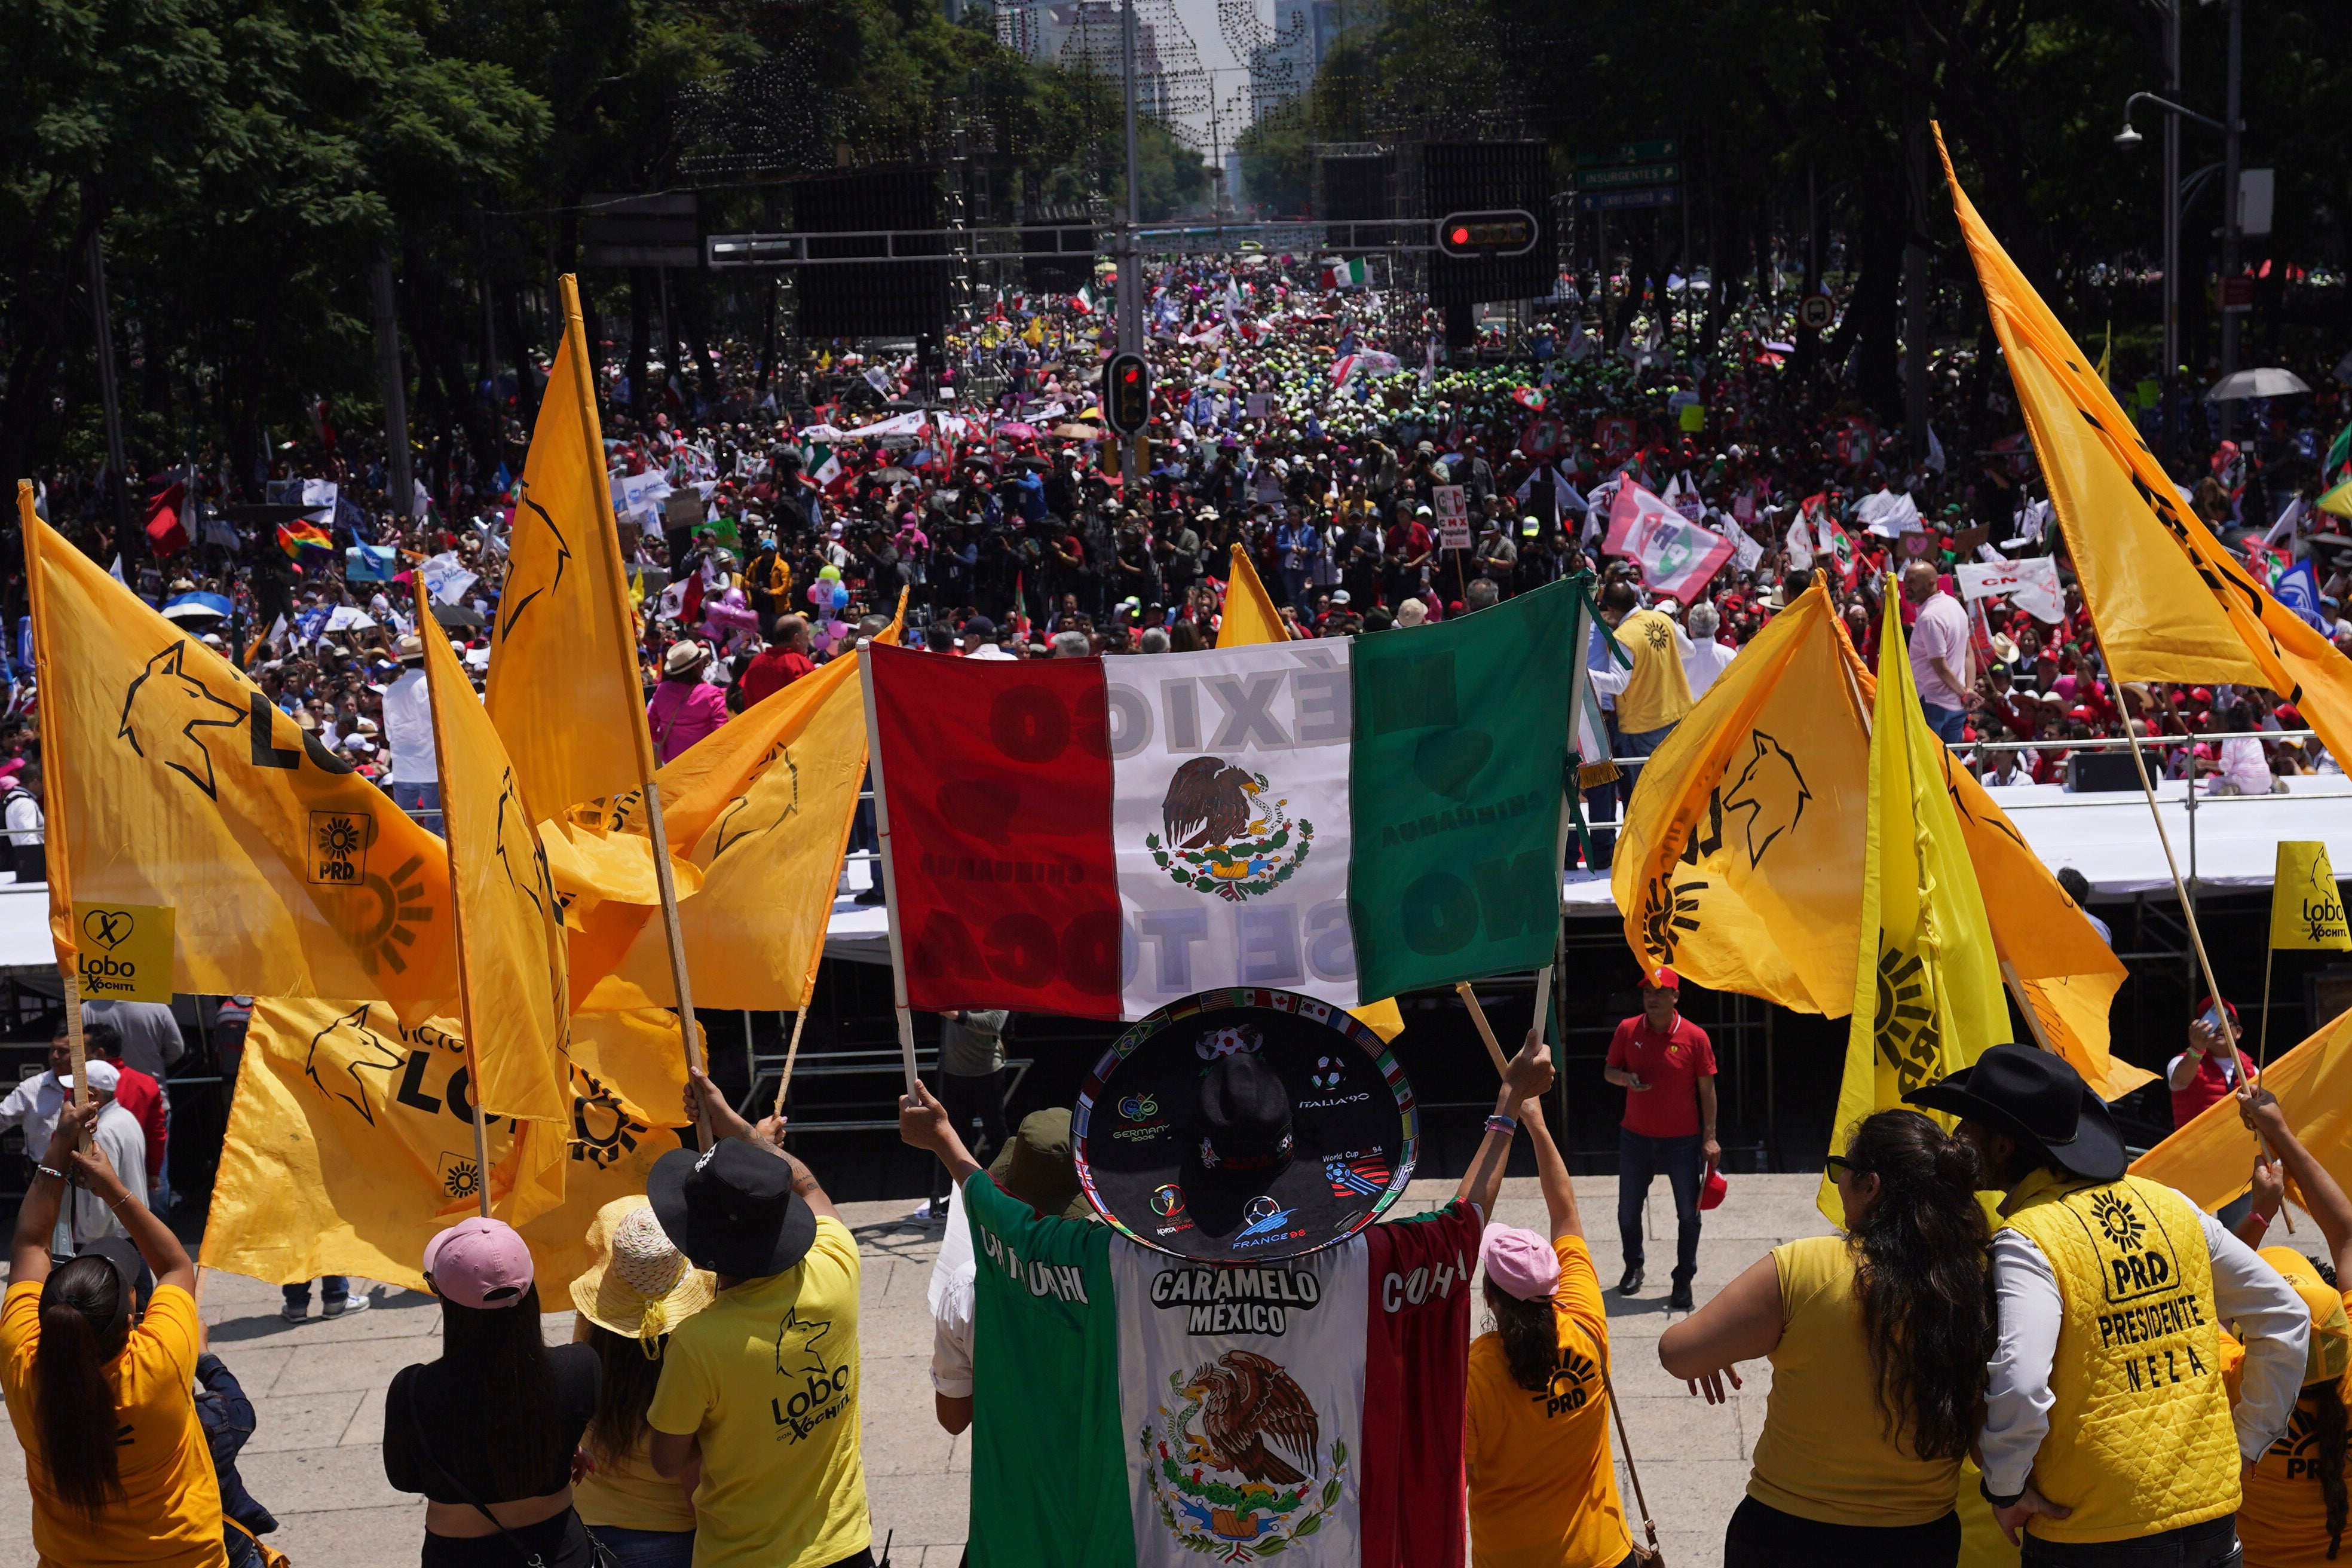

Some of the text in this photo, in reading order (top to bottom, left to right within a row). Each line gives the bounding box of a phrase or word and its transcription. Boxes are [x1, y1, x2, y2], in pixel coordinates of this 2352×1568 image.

[320, 861, 354, 880] PRD
[2308, 920, 2347, 942] XÓCHITL
[85, 973, 136, 994] XÓCHITL
[398, 1018, 464, 1053] VICTO
[1113, 1123, 1171, 1139] GERMANY
[1322, 1153, 1343, 1162] World
[1232, 1229, 1306, 1250] FRANCE 98
[1151, 1268, 1319, 1303] CARAMELO
[2112, 1251, 2169, 1294] PRD
[1189, 1298, 1285, 1333] MÉXICO
[2098, 1295, 2204, 1349] PRESIDENTE
[2126, 1346, 2207, 1392] NEZA
[1547, 1388, 1587, 1419] PRD
[776, 1393, 850, 1446] CON XÓCHITL
[2287, 1458, 2323, 1480] PR
